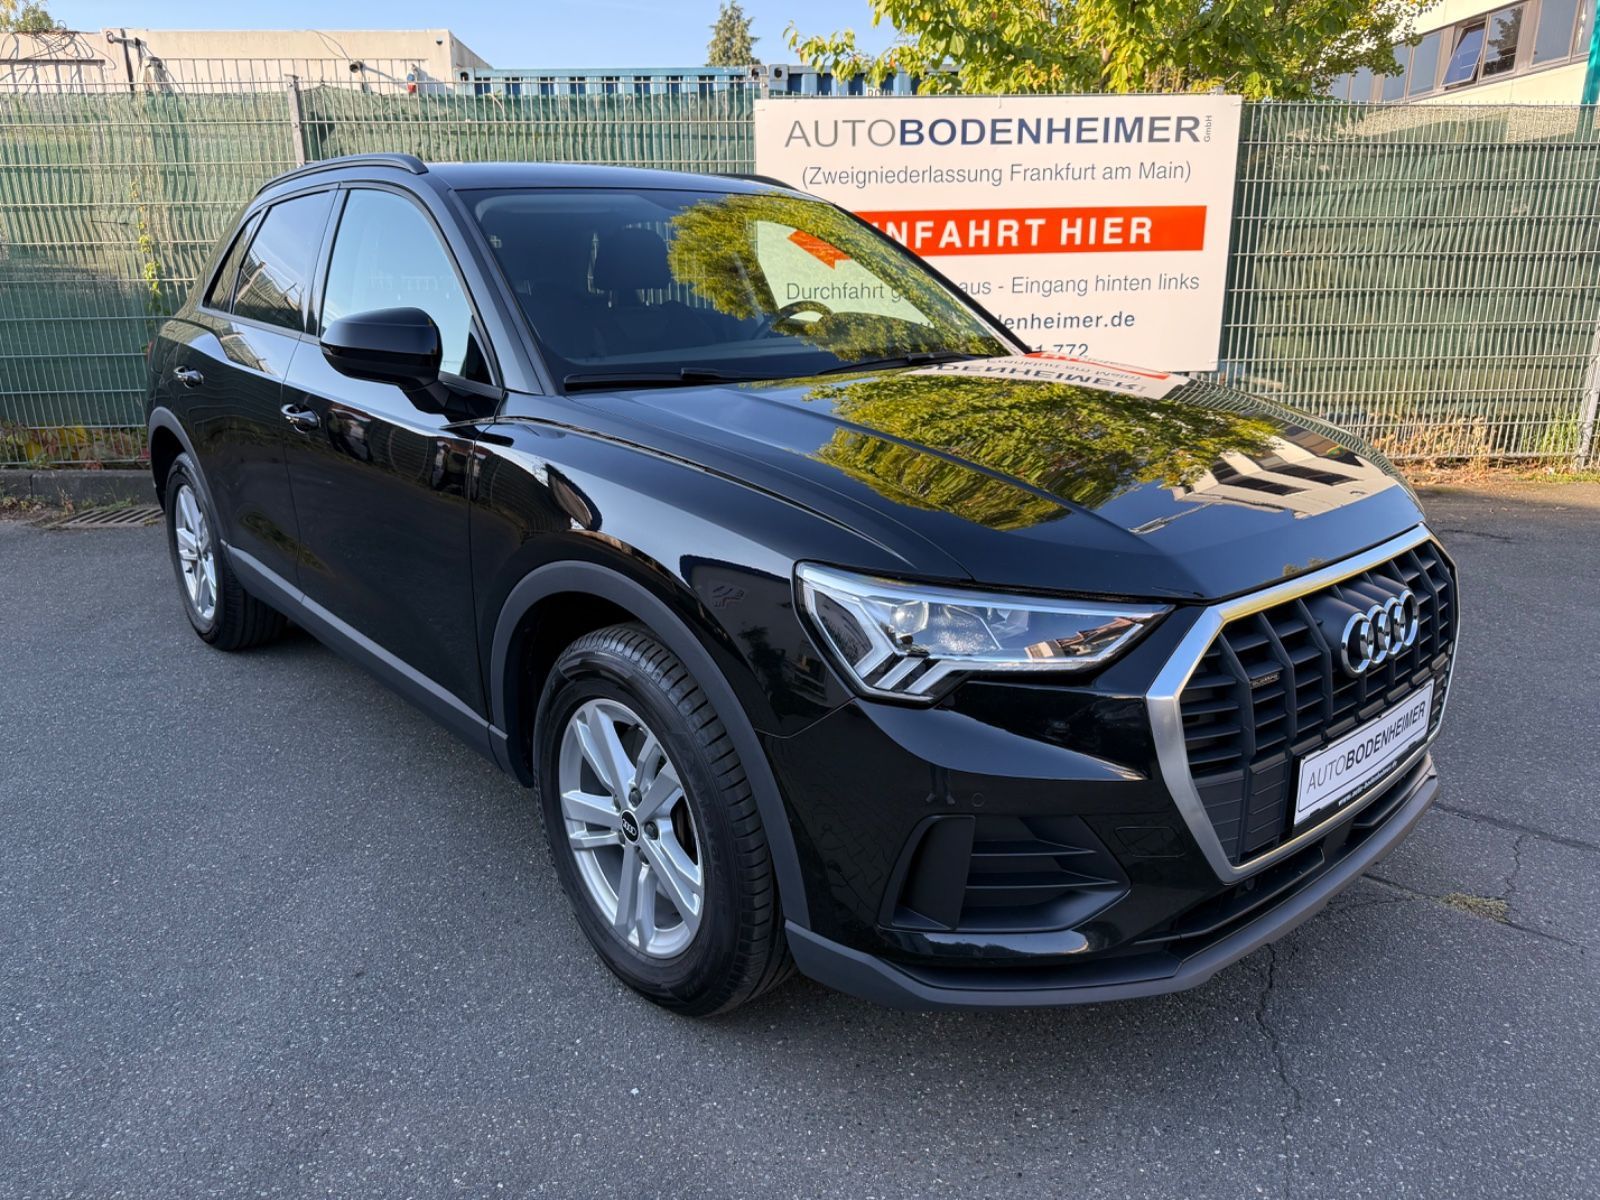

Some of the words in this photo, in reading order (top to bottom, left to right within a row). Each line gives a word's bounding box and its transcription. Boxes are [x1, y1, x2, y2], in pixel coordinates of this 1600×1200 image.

[784, 115, 1200, 148] AUTOBODENHEIMER
[1204, 115, 1213, 143] GmbH
[802, 165, 1003, 189] (Zweigniederlassung
[1010, 162, 1096, 182] Frankfurt
[1102, 166, 1131, 180] am
[1138, 160, 1192, 183] Main)
[873, 218, 1047, 249] NFAHRT
[1060, 216, 1153, 246] HIER
[786, 282, 884, 301] Durchfahrt
[1011, 276, 1089, 297] Eingang
[1095, 274, 1151, 292] hinten
[1158, 273, 1201, 290] links
[1306, 700, 1426, 794] AUTOBODENHEIMER
